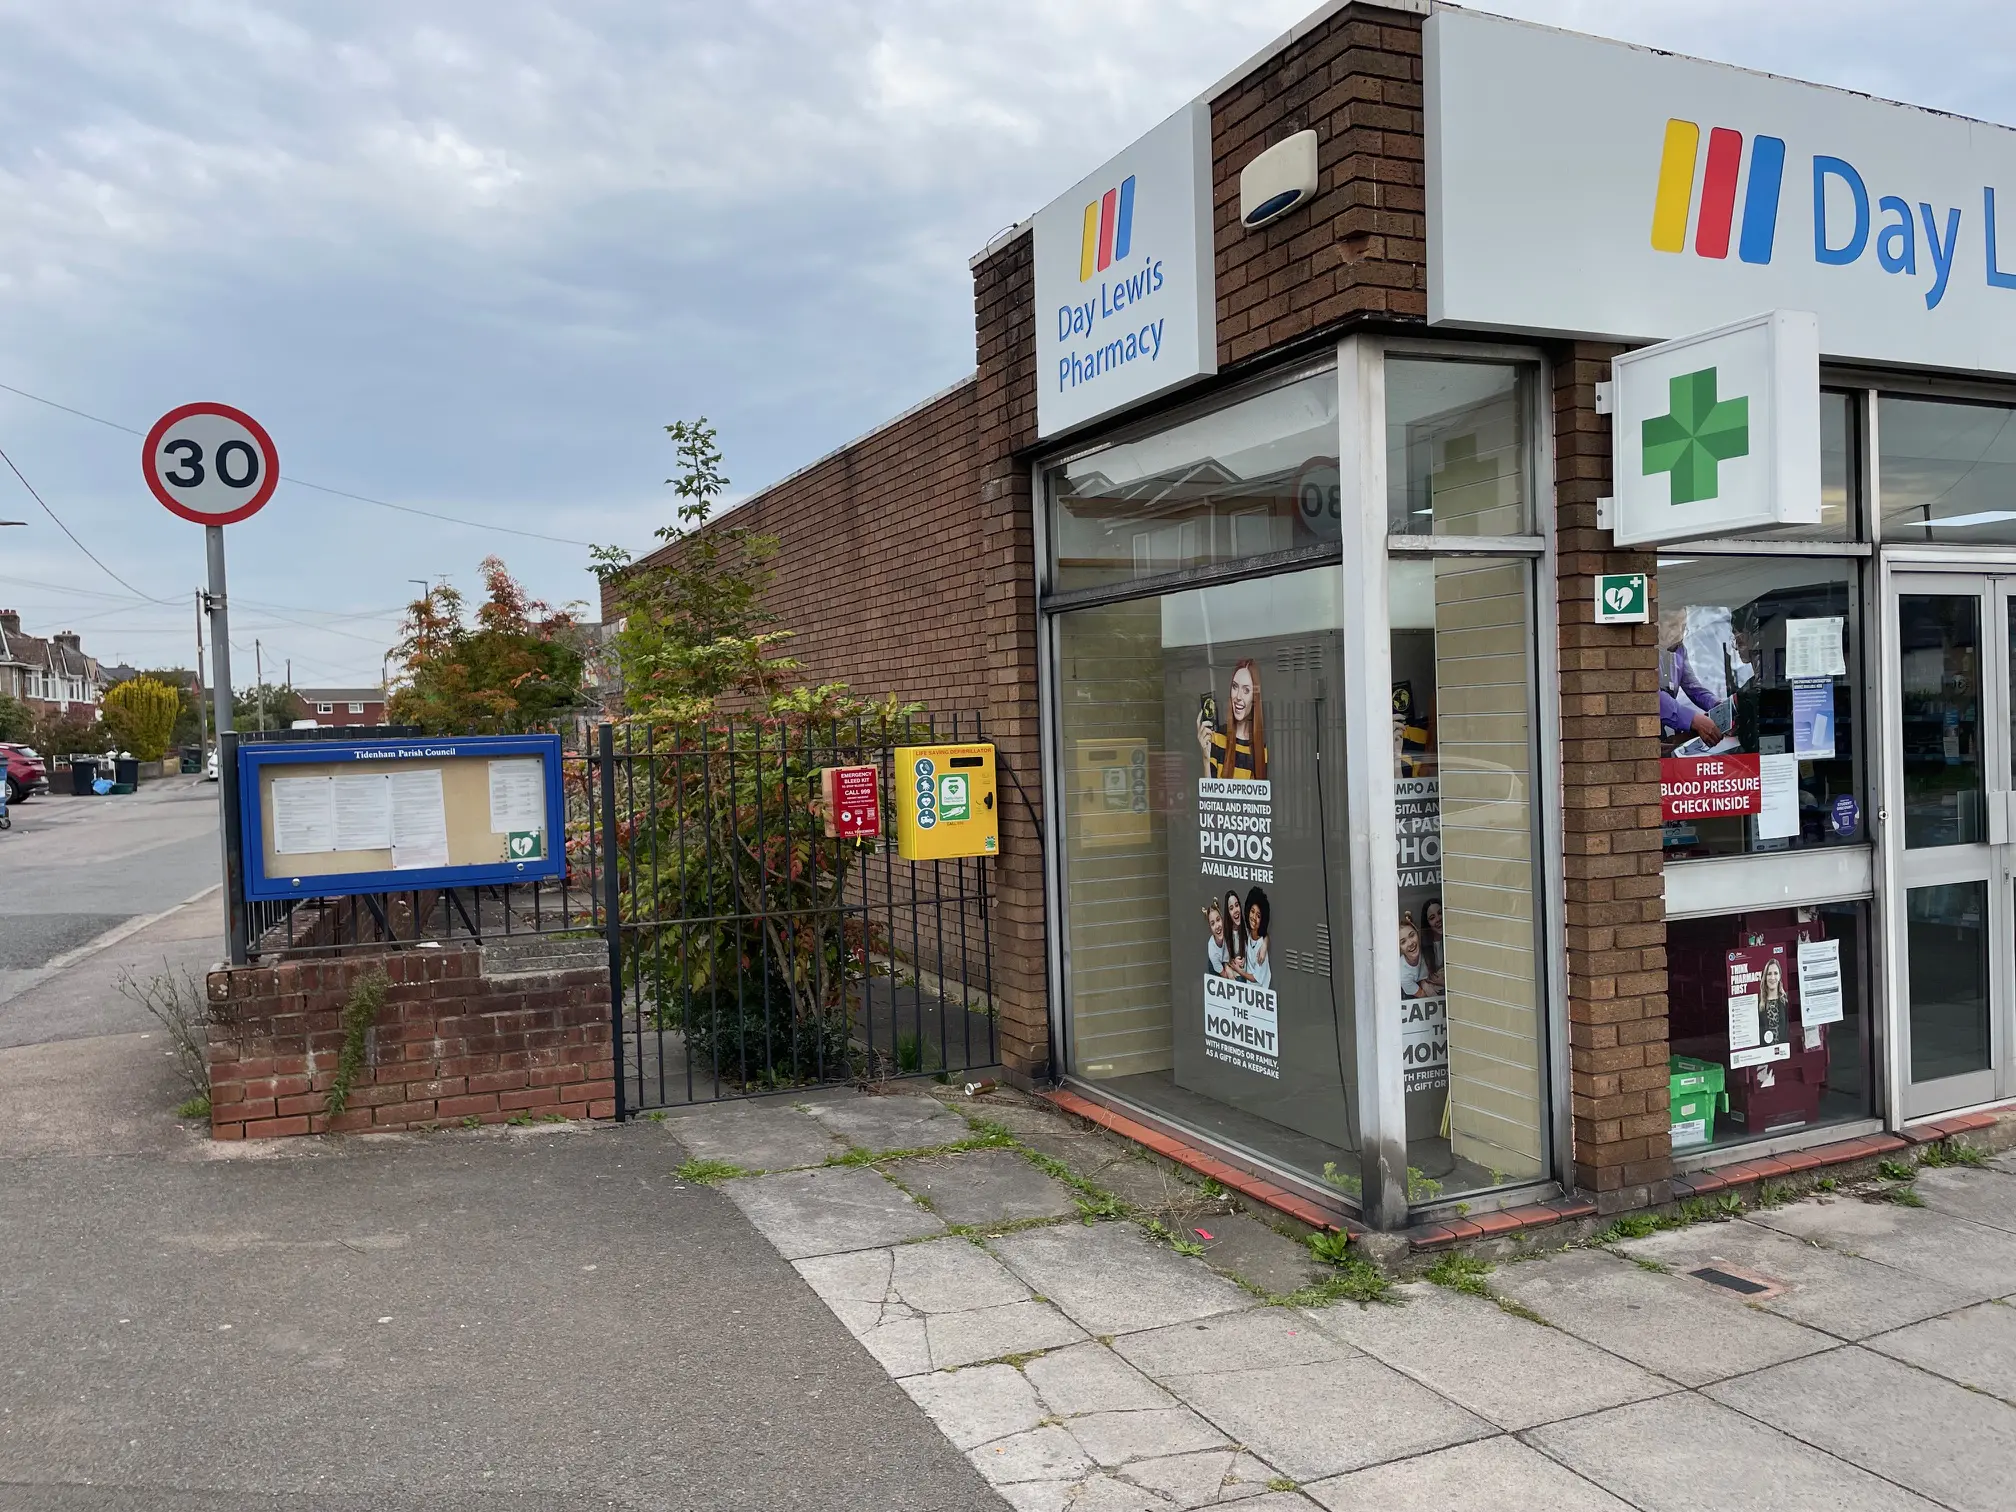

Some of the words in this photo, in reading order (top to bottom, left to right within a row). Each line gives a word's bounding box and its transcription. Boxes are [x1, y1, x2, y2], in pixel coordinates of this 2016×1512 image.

[1812, 154, 1962, 311] Day
[1058, 298, 1096, 343] Day
[1102, 256, 1164, 318] Lewis
[1059, 317, 1164, 393] Pharmacy
[163, 438, 259, 489] 30
[354, 750, 396, 759] Tidenham
[398, 749, 423, 757] Parish
[425, 747, 456, 756] Council
[949, 747, 992, 755] DEFIBRILLATOR
[1696, 761, 1724, 776] FREE
[1201, 782, 1225, 794] HMPO
[1226, 783, 1268, 796] APPROVED
[1395, 782, 1424, 795] MPO
[1660, 781, 1701, 797] BLOOD
[1703, 777, 1760, 794] PRESSURE
[1199, 801, 1224, 812] DIGITAL
[1225, 802, 1241, 812] AND
[1242, 803, 1271, 815] PRINTED
[1671, 798, 1710, 814] CHECK
[1712, 795, 1750, 811] INSIDE
[1199, 813, 1215, 828] UK
[1217, 815, 1272, 833] PASSPORT
[1200, 830, 1273, 862] PHOTOS
[1201, 862, 1248, 880] AVAILABLE
[1250, 868, 1274, 884] HERE
[1731, 971, 1762, 985] PHARMACY
[1207, 978, 1275, 1012] CAPTURE
[1731, 984, 1747, 995] FIRST
[1232, 1006, 1249, 1020] THE
[1207, 1013, 1275, 1050] MOMENT
[1205, 1039, 1220, 1049] WITH
[1220, 1043, 1245, 1058] FRIENDS
[1245, 1051, 1255, 1061] OR
[1255, 1054, 1280, 1070] FAMILY,
[1205, 1048, 1214, 1057] AS
[1214, 1051, 1219, 1059] A
[1219, 1053, 1232, 1063] GIFT
[1232, 1056, 1242, 1066] OR
[1242, 1060, 1248, 1069] A
[1248, 1062, 1280, 1080] KEEPSAKE
[1405, 1084, 1413, 1093] A
[1414, 1081, 1433, 1092] GIFT
[1434, 1080, 1447, 1088] OR
